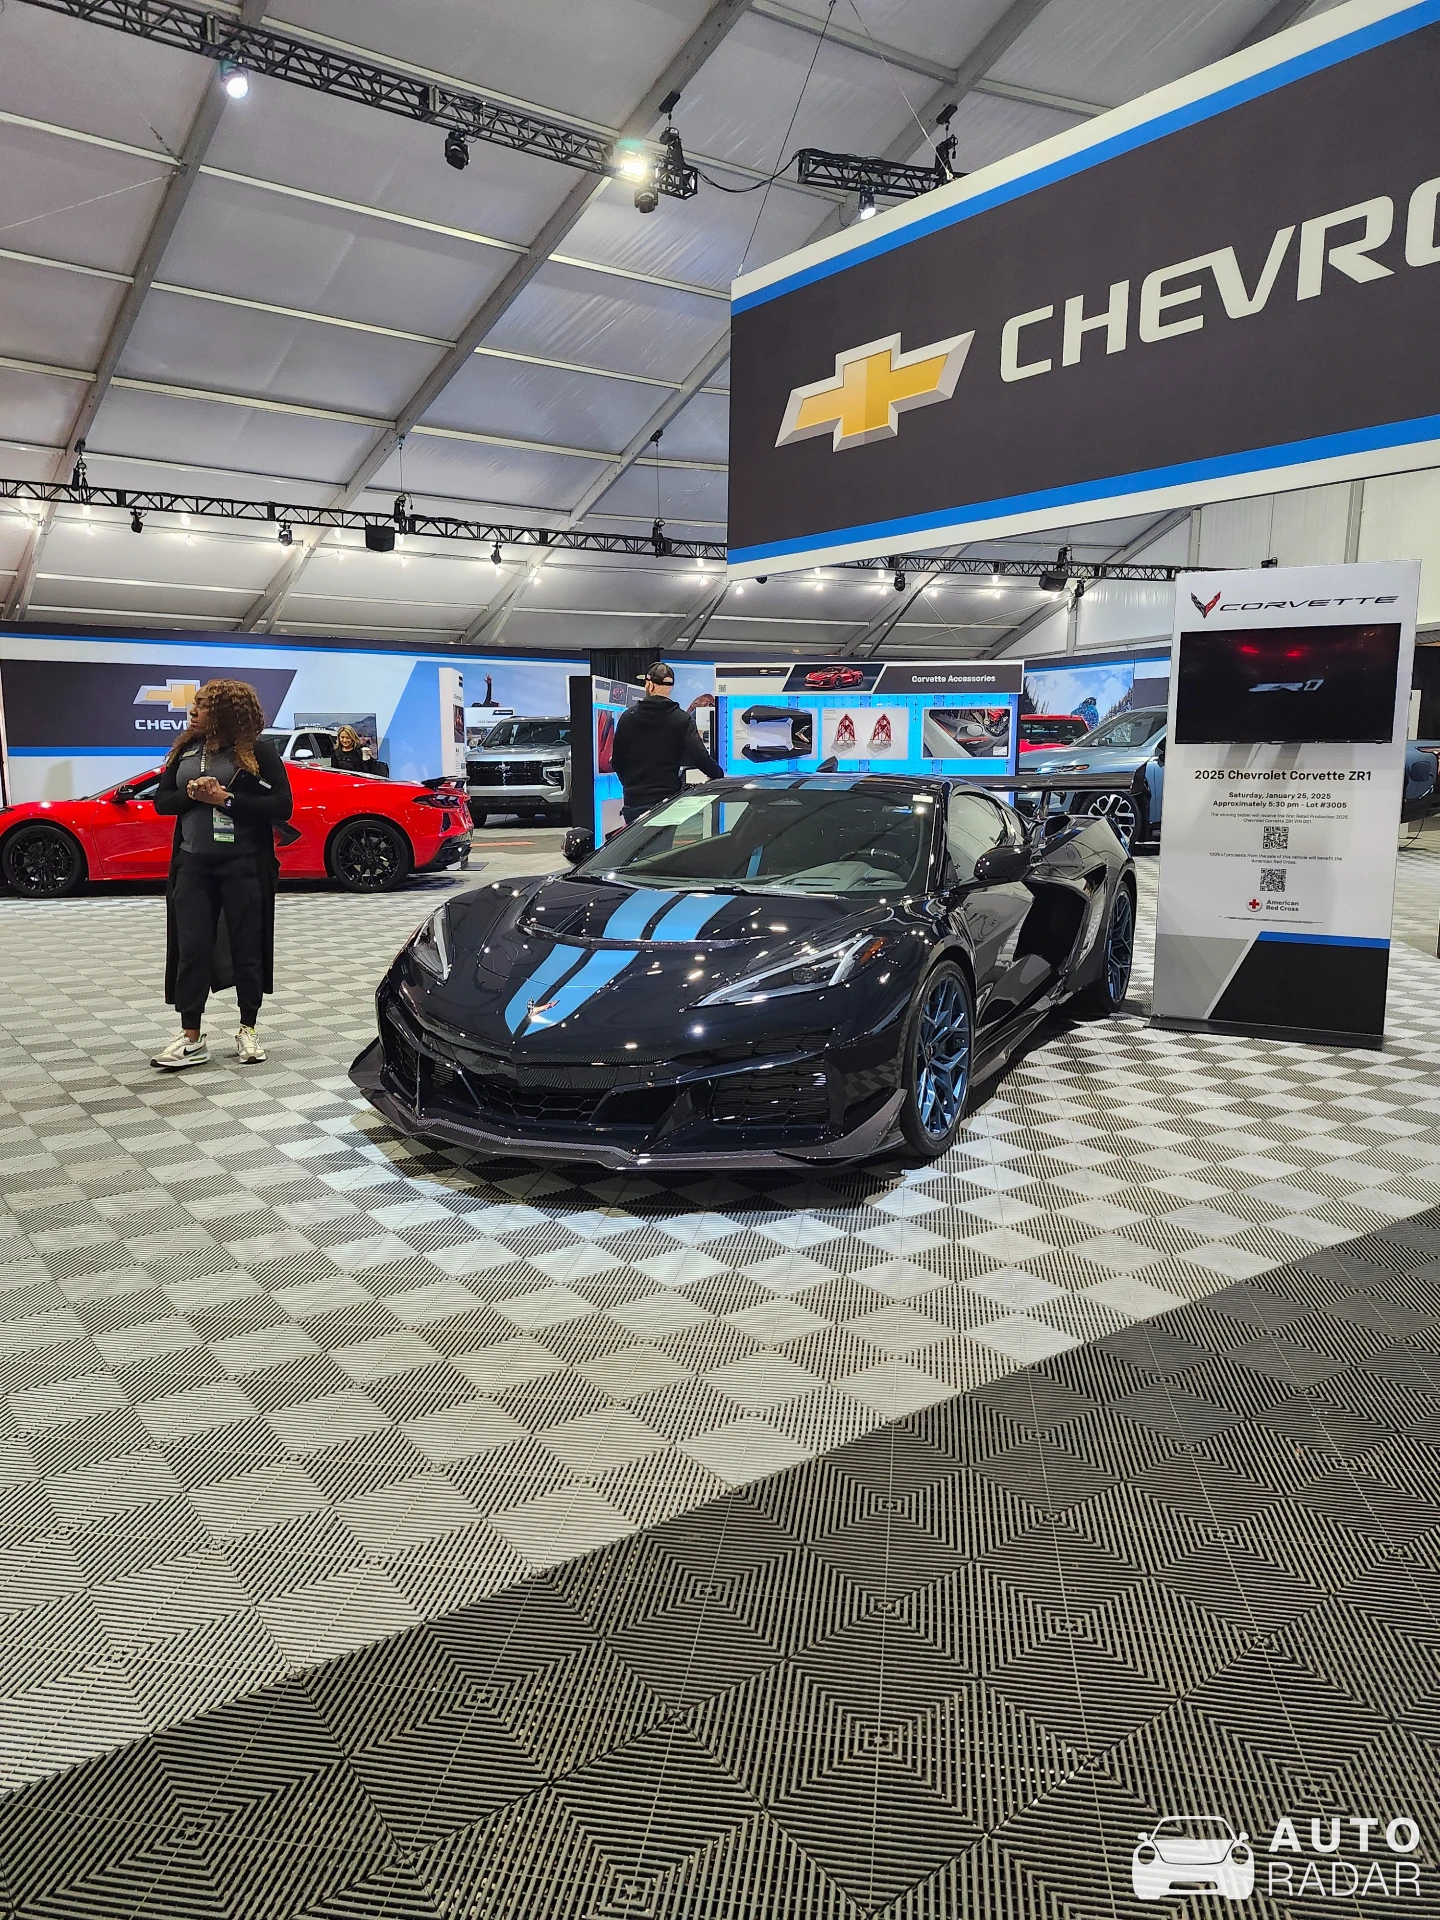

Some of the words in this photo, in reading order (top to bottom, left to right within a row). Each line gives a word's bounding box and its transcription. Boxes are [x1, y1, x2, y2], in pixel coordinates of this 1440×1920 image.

[1219, 595, 1400, 612] CORVETTE
[911, 675, 947, 683] Corvette
[947, 674, 996, 683] Accessories
[1194, 770, 1225, 780] 2025
[1227, 770, 1287, 780] Chevrolet
[1289, 770, 1346, 781] Corvette
[1348, 771, 1372, 781] ZR1
[1228, 792, 1264, 800] Saturday,
[1264, 792, 1296, 800] January
[1296, 792, 1309, 800] 25,
[1212, 800, 1267, 808] Approximately
